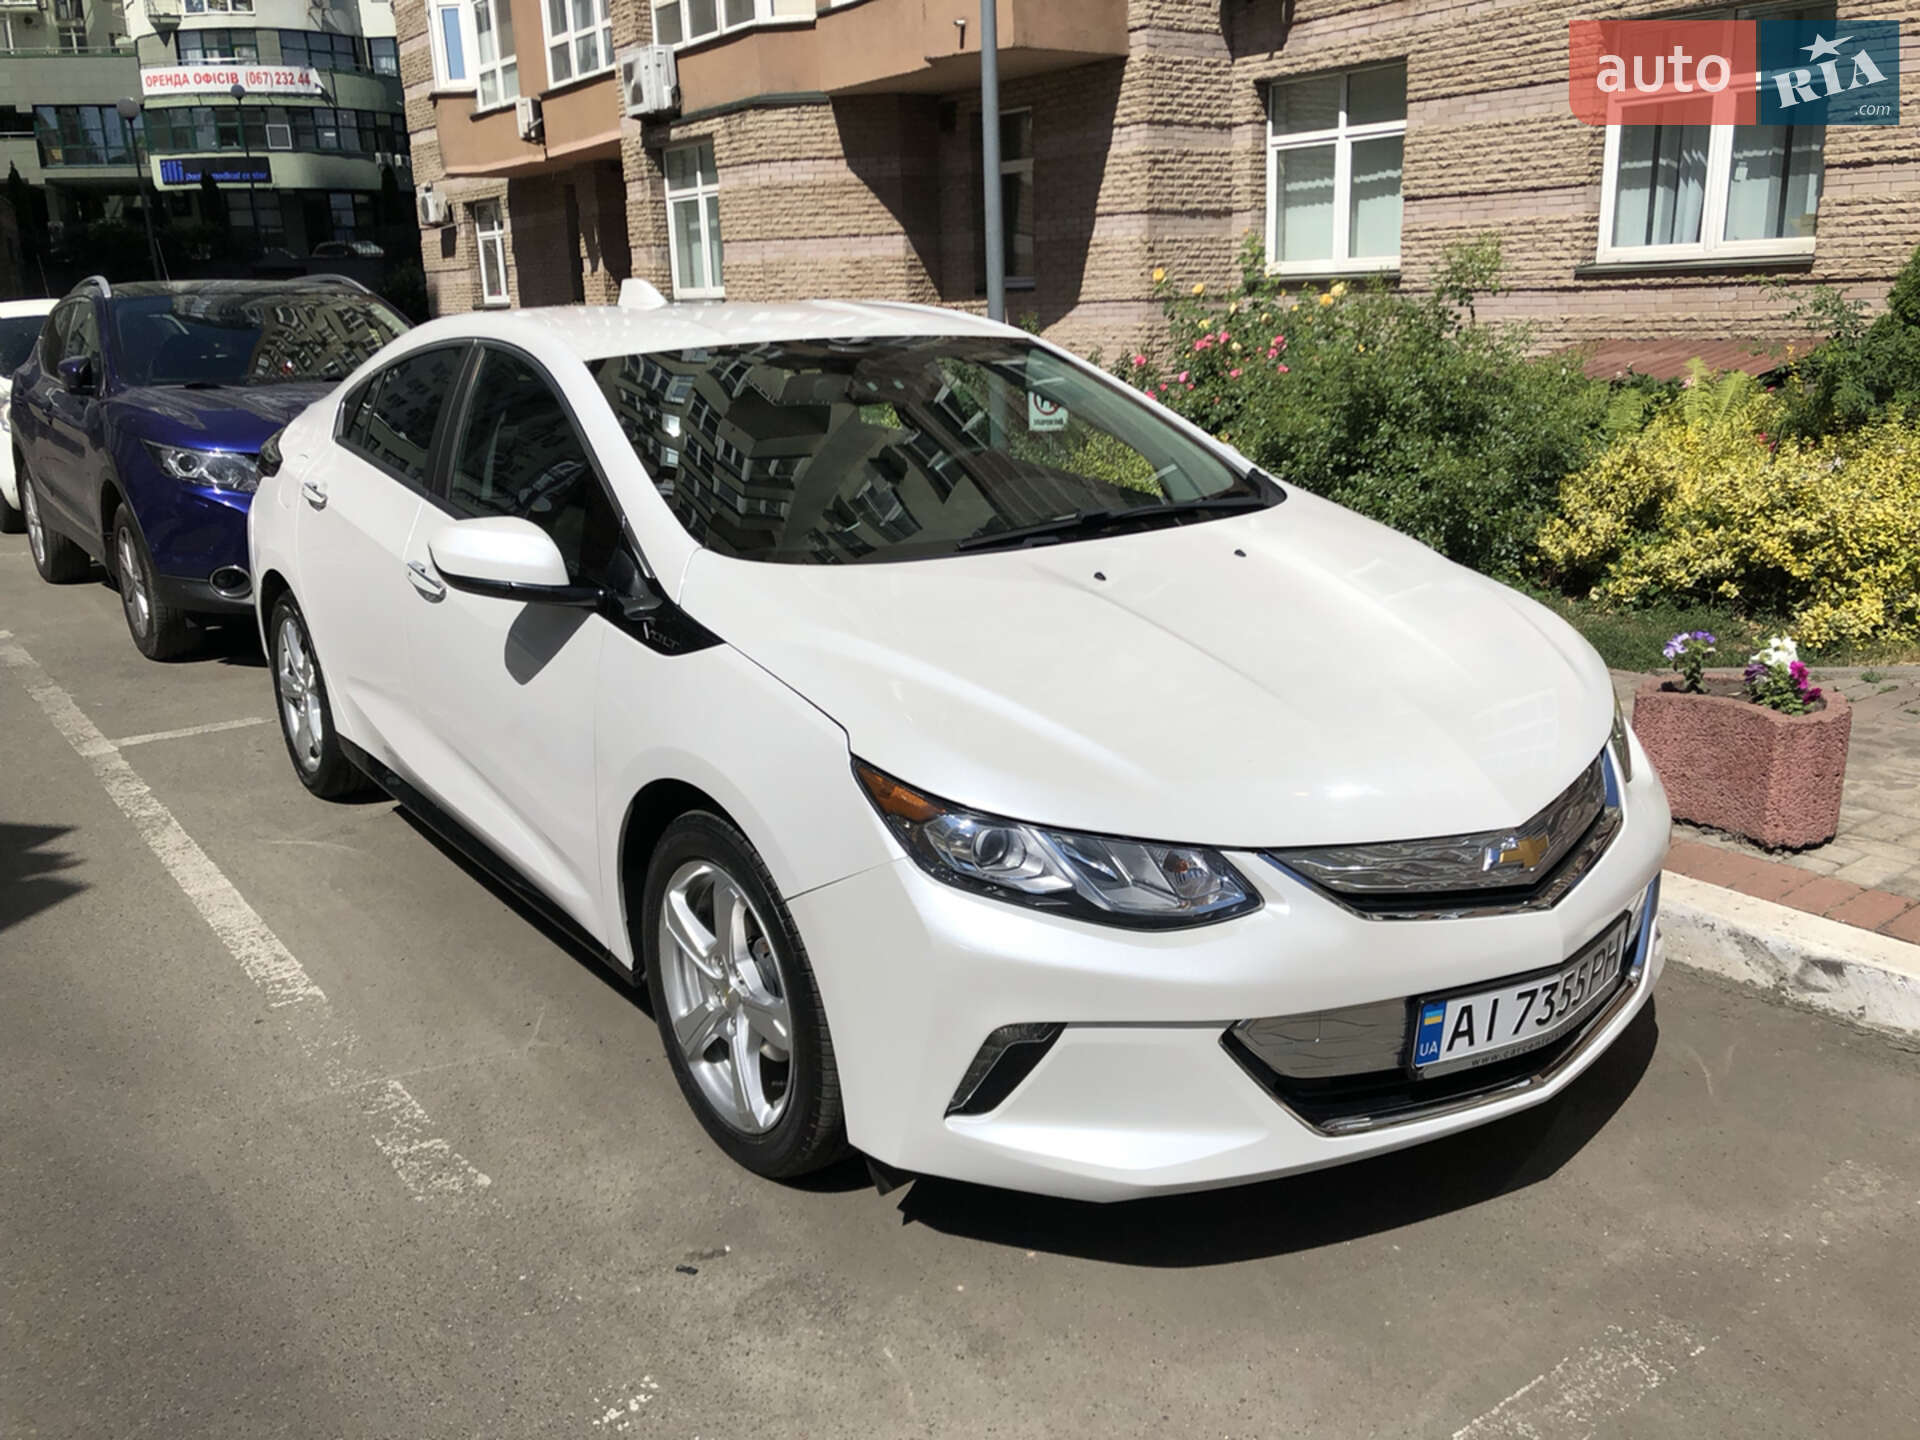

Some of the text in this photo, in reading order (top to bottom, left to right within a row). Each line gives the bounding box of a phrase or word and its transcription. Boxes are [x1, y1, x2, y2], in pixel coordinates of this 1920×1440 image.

[145, 73, 189, 88] ОРЕНДА
[193, 71, 239, 84] ОФІСІВ
[244, 71, 274, 88] (067)
[275, 71, 295, 85] 232
[1446, 998, 1499, 1052] AI
[1512, 963, 1589, 1036] 7355
[1419, 1040, 1438, 1056] UA
